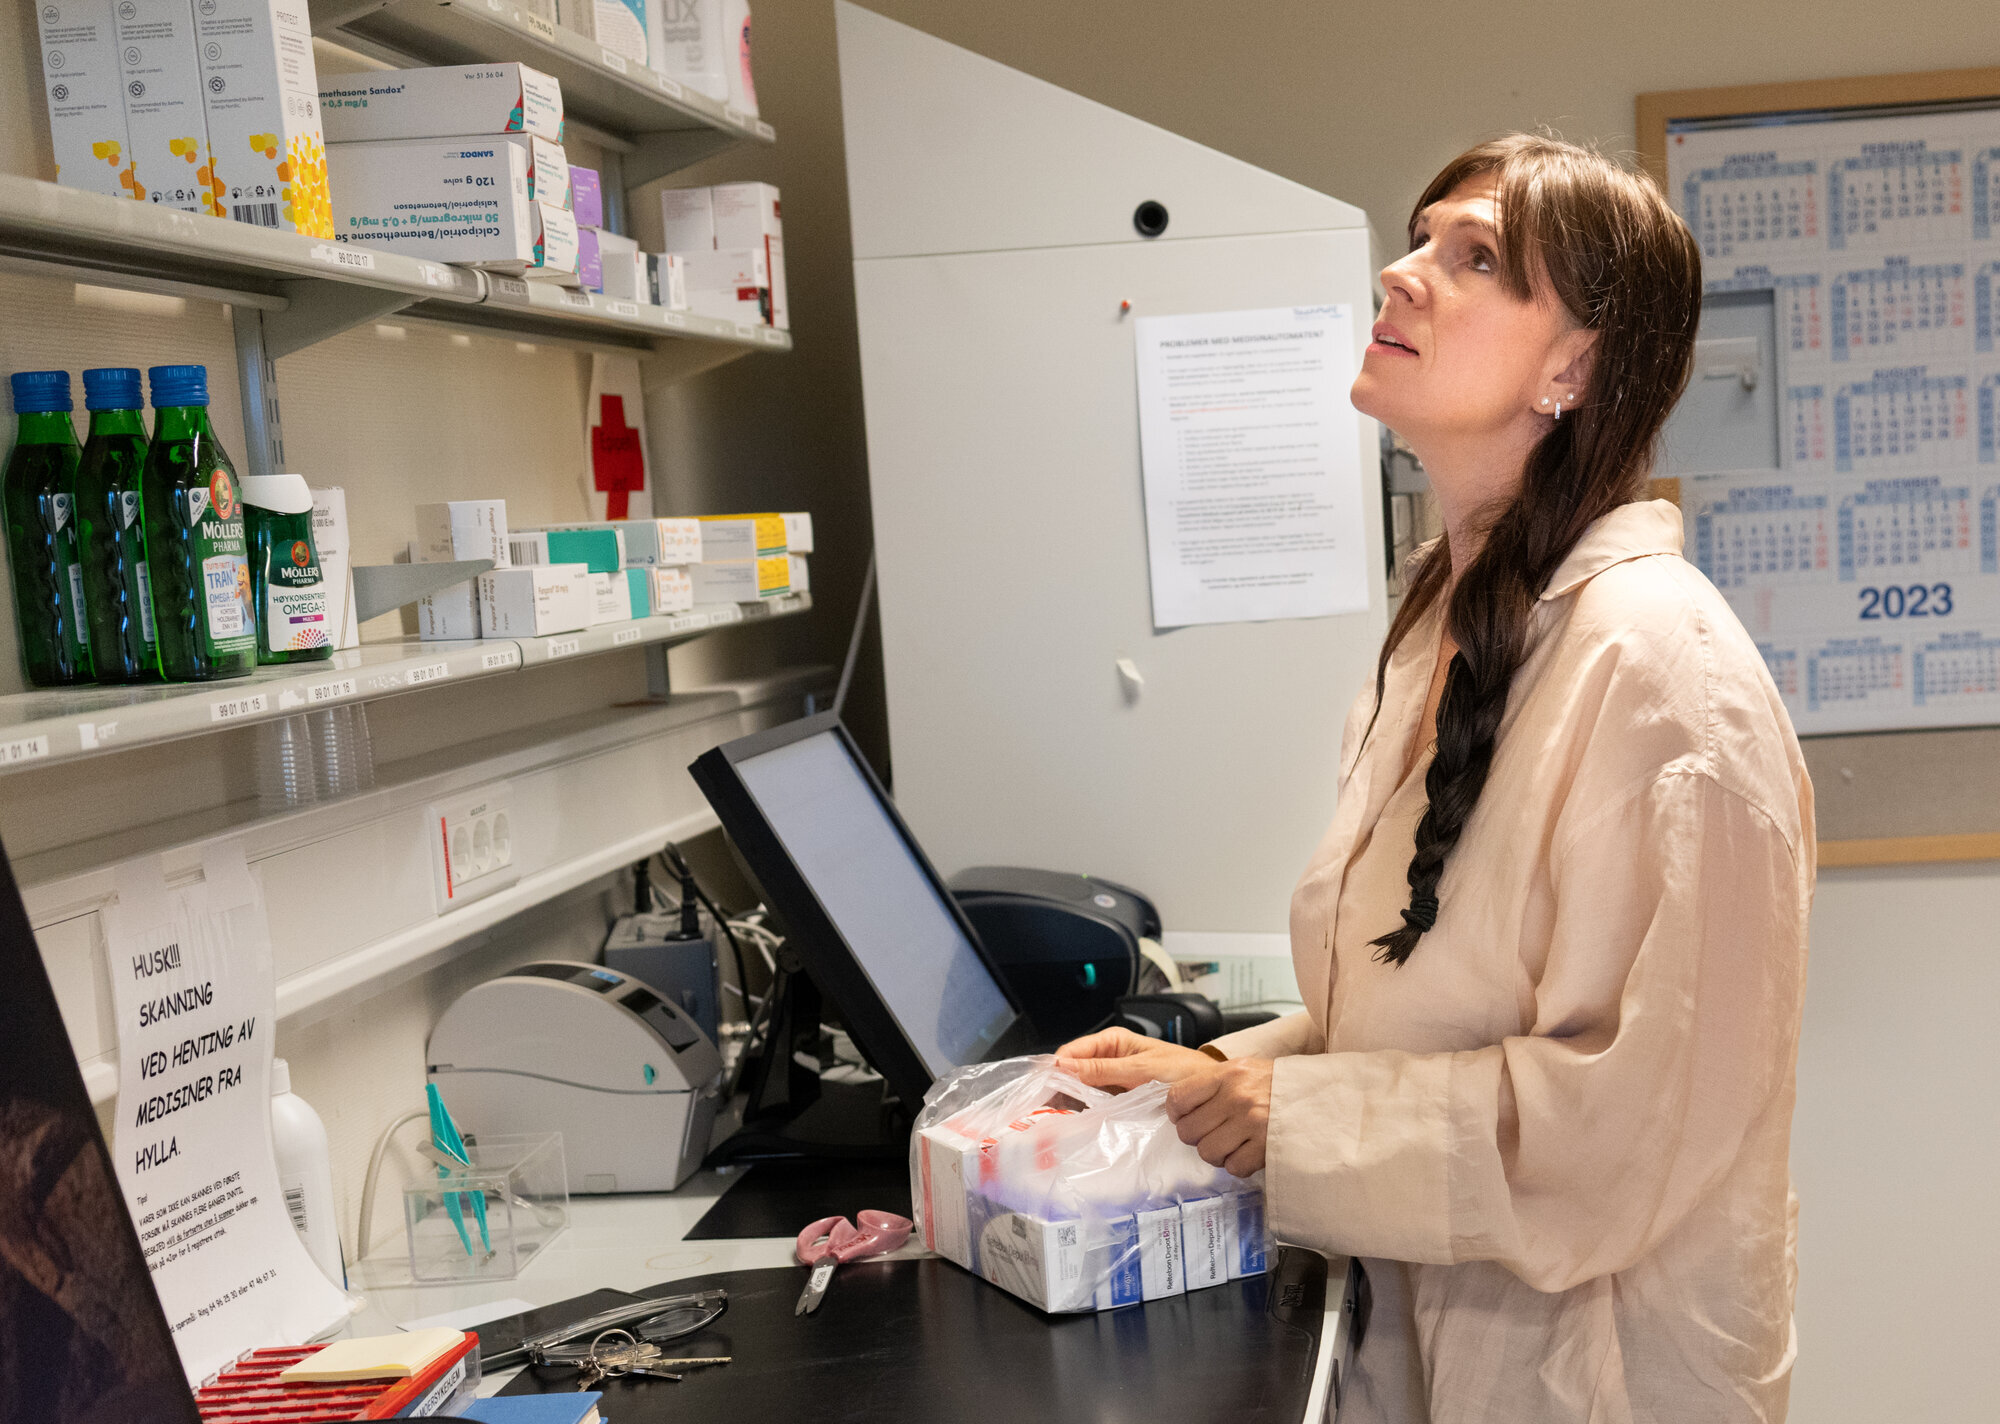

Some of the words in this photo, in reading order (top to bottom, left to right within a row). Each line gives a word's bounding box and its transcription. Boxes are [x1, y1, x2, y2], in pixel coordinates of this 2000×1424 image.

[344, 98, 367, 108] mg/g
[466, 176, 472, 184] g
[476, 177, 495, 186] 120
[394, 200, 498, 210] kalsipotriol/betametason
[350, 216, 379, 228] mg/g
[382, 217, 399, 227] 0,5
[410, 213, 482, 226] mikrogram/g
[485, 213, 498, 223] 50
[351, 226, 500, 242] Calcipotriol/Betamethasone
[338, 253, 346, 262] 99
[1160, 338, 1208, 348] PROBLEMER
[1211, 337, 1228, 345] MED
[1866, 476, 1941, 490] NOVEMBER
[213, 540, 240, 552] PHARMA
[207, 569, 233, 589] TRAN
[209, 592, 234, 604] OMEGA-3
[1860, 582, 1953, 619] 2023
[283, 601, 326, 615] OMEGA-3
[413, 671, 419, 681] 99
[420, 670, 426, 680] 01
[428, 668, 434, 678] 01
[437, 666, 442, 675] 17
[315, 688, 322, 699] 99
[324, 687, 330, 698] 01
[333, 684, 340, 696] 01
[343, 682, 350, 693] 16
[220, 705, 228, 717] 99
[229, 703, 237, 715] 01
[241, 702, 248, 713] 01
[252, 698, 260, 709] 15
[11, 746, 21, 759] 01
[28, 741, 38, 755] 14
[132, 943, 181, 980] HUSK!!!
[139, 981, 213, 1028] SKANNING
[141, 1051, 167, 1080] VED
[172, 1025, 233, 1068] HENTING
[238, 1016, 256, 1043] AV
[136, 1074, 214, 1128] MEDISINER
[218, 1064, 241, 1094] FRA
[136, 1136, 181, 1174] HYLLA.
[139, 1213, 155, 1226] VARER
[156, 1207, 167, 1219] SOM
[168, 1200, 179, 1213] IKKE
[180, 1195, 190, 1207] KAN
[191, 1185, 212, 1202] SKANNES
[213, 1180, 222, 1191] VED
[223, 1171, 240, 1186] FØRSTE
[141, 1227, 161, 1243] FORSØK
[162, 1220, 170, 1231] MÅ
[171, 1210, 193, 1228] SKANNES
[193, 1203, 207, 1216] FLERE
[208, 1194, 226, 1209] GANGER
[226, 1186, 244, 1200] INNTIL
[159, 1257, 165, 1270] på
[192, 1235, 212, 1251] registrere
[209, 1302, 216, 1311] 64
[216, 1298, 223, 1307] 96
[223, 1294, 230, 1303] 25
[230, 1290, 237, 1299] 30
[238, 1286, 248, 1295] eller
[249, 1280, 254, 1288] 47
[262, 1272, 268, 1281] 67
[269, 1269, 276, 1278] 31
